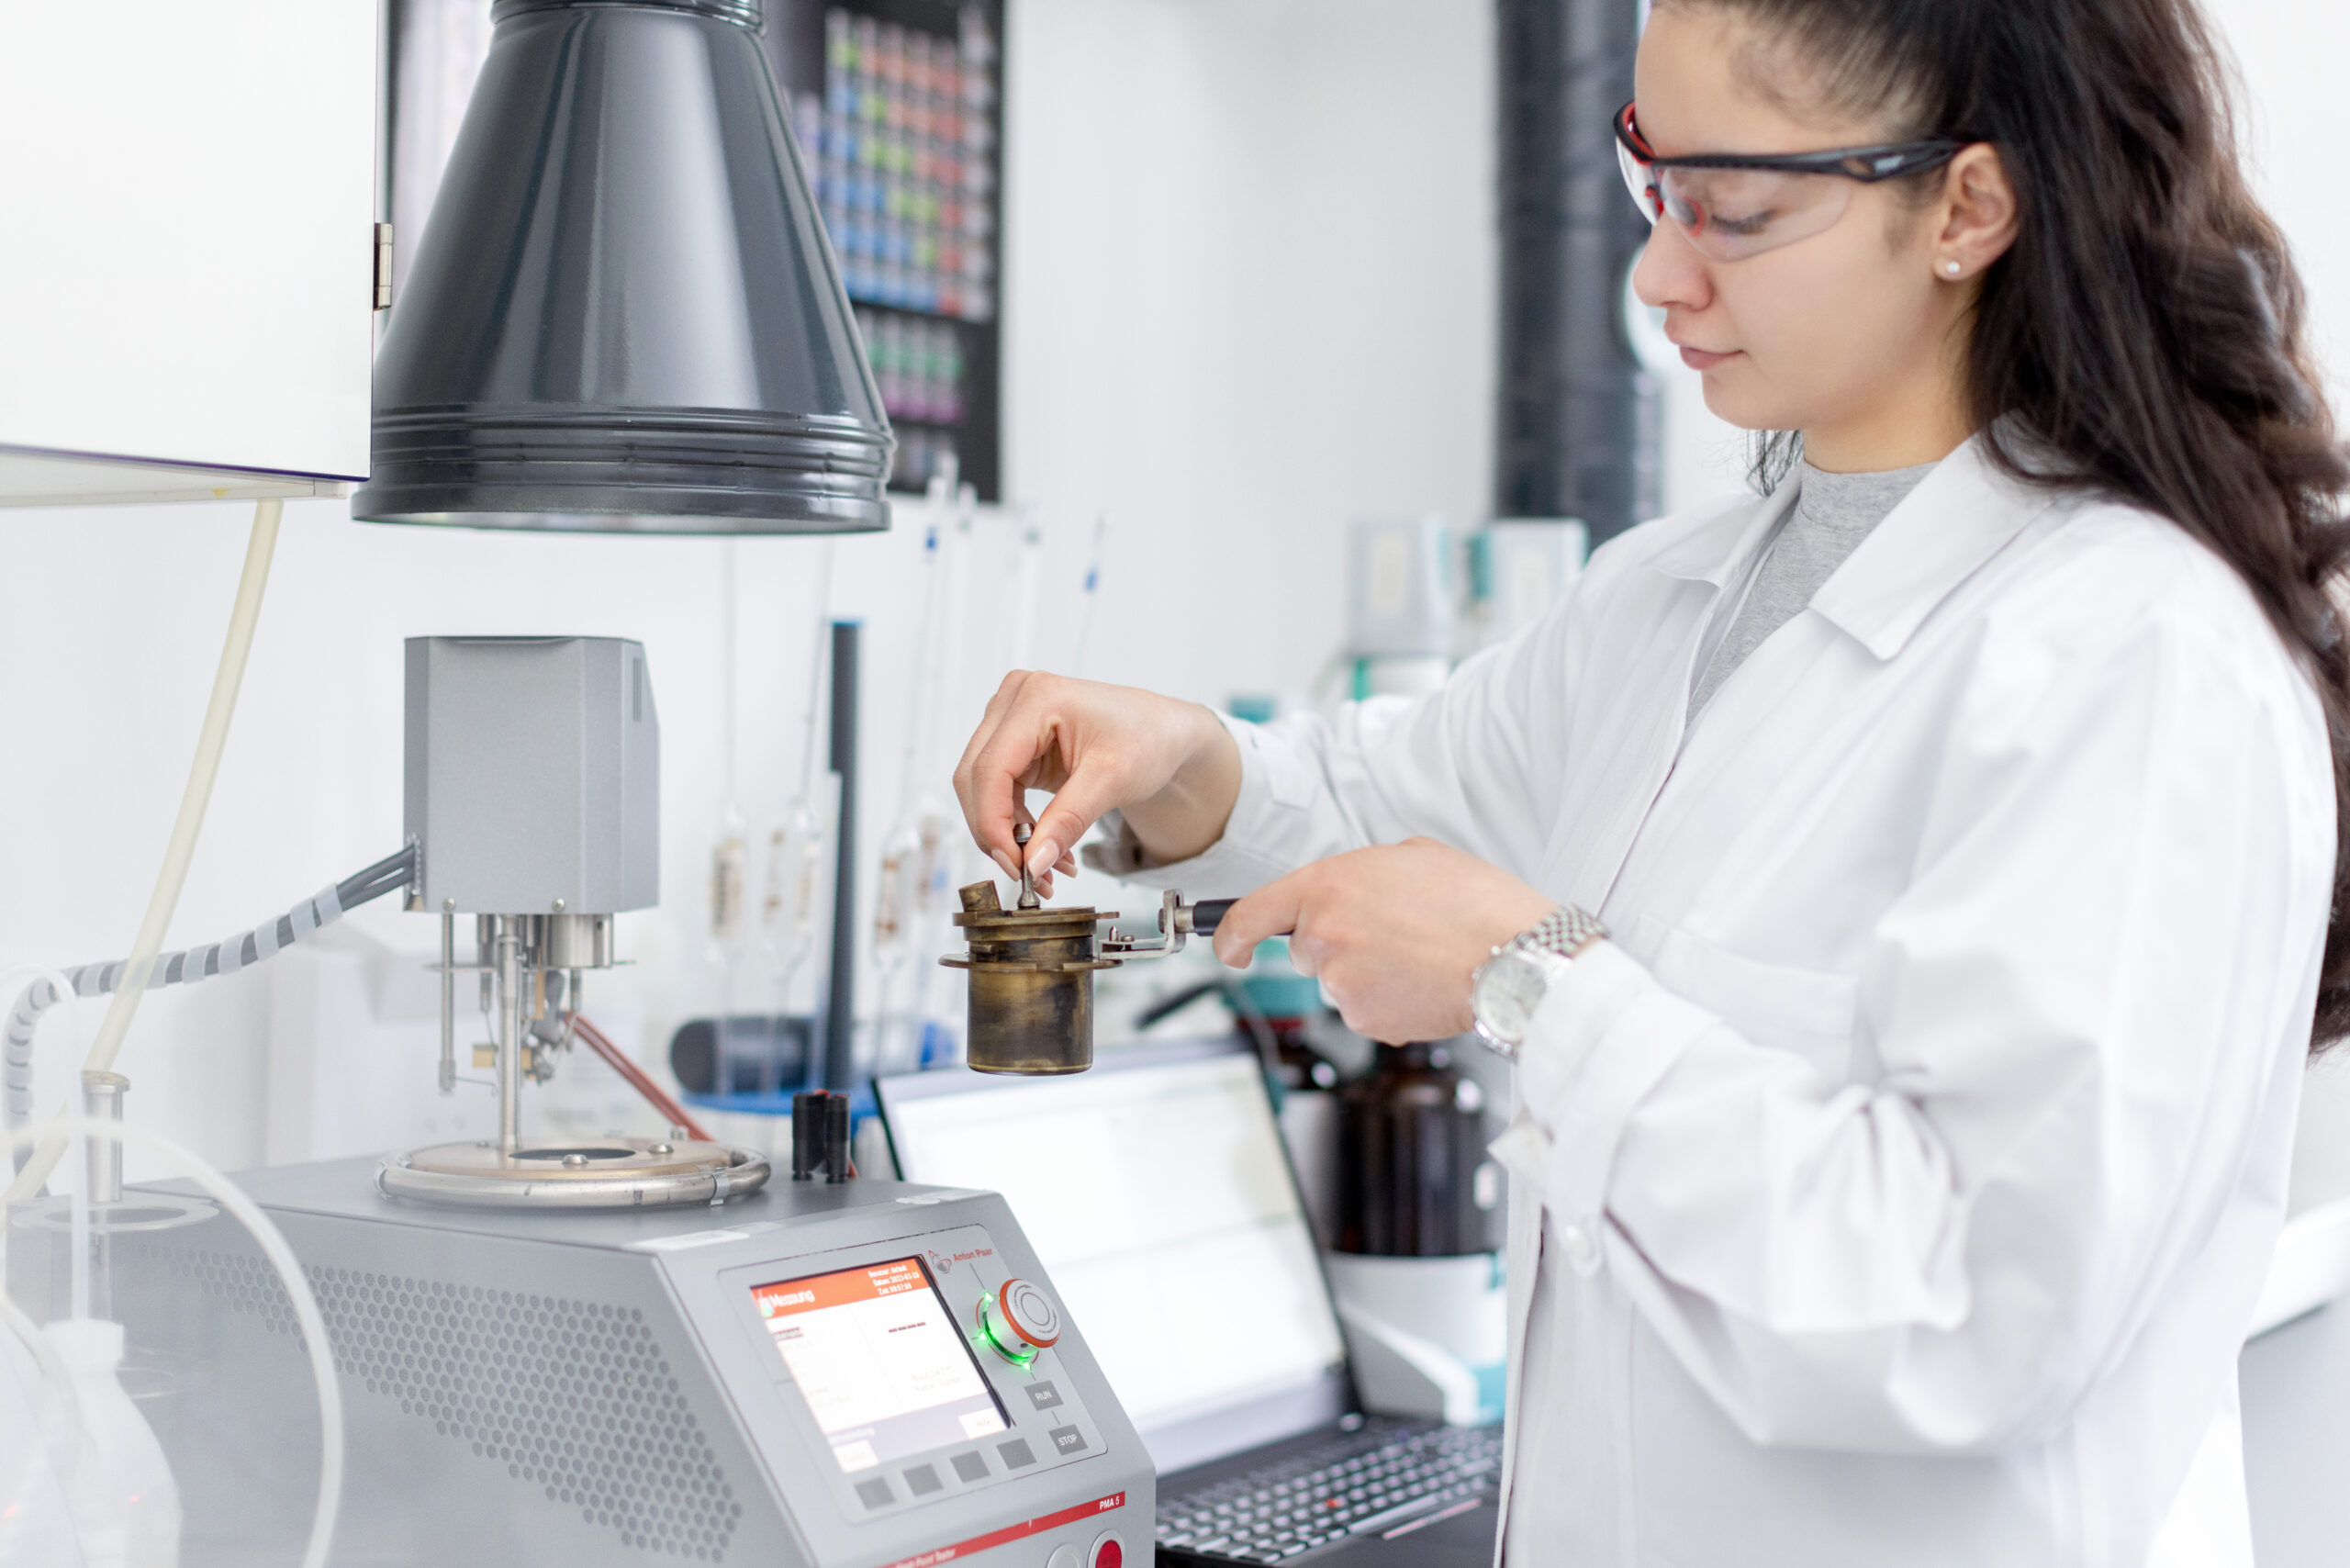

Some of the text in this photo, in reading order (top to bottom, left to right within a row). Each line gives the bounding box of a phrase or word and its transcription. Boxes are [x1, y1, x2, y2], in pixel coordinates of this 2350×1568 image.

[953, 1249, 992, 1262] Anton Paar
[769, 1290, 815, 1307] Messung
[1035, 1390, 1052, 1401] RUN
[1058, 1434, 1077, 1446] STOP
[1100, 1495, 1120, 1510] PMA 5
